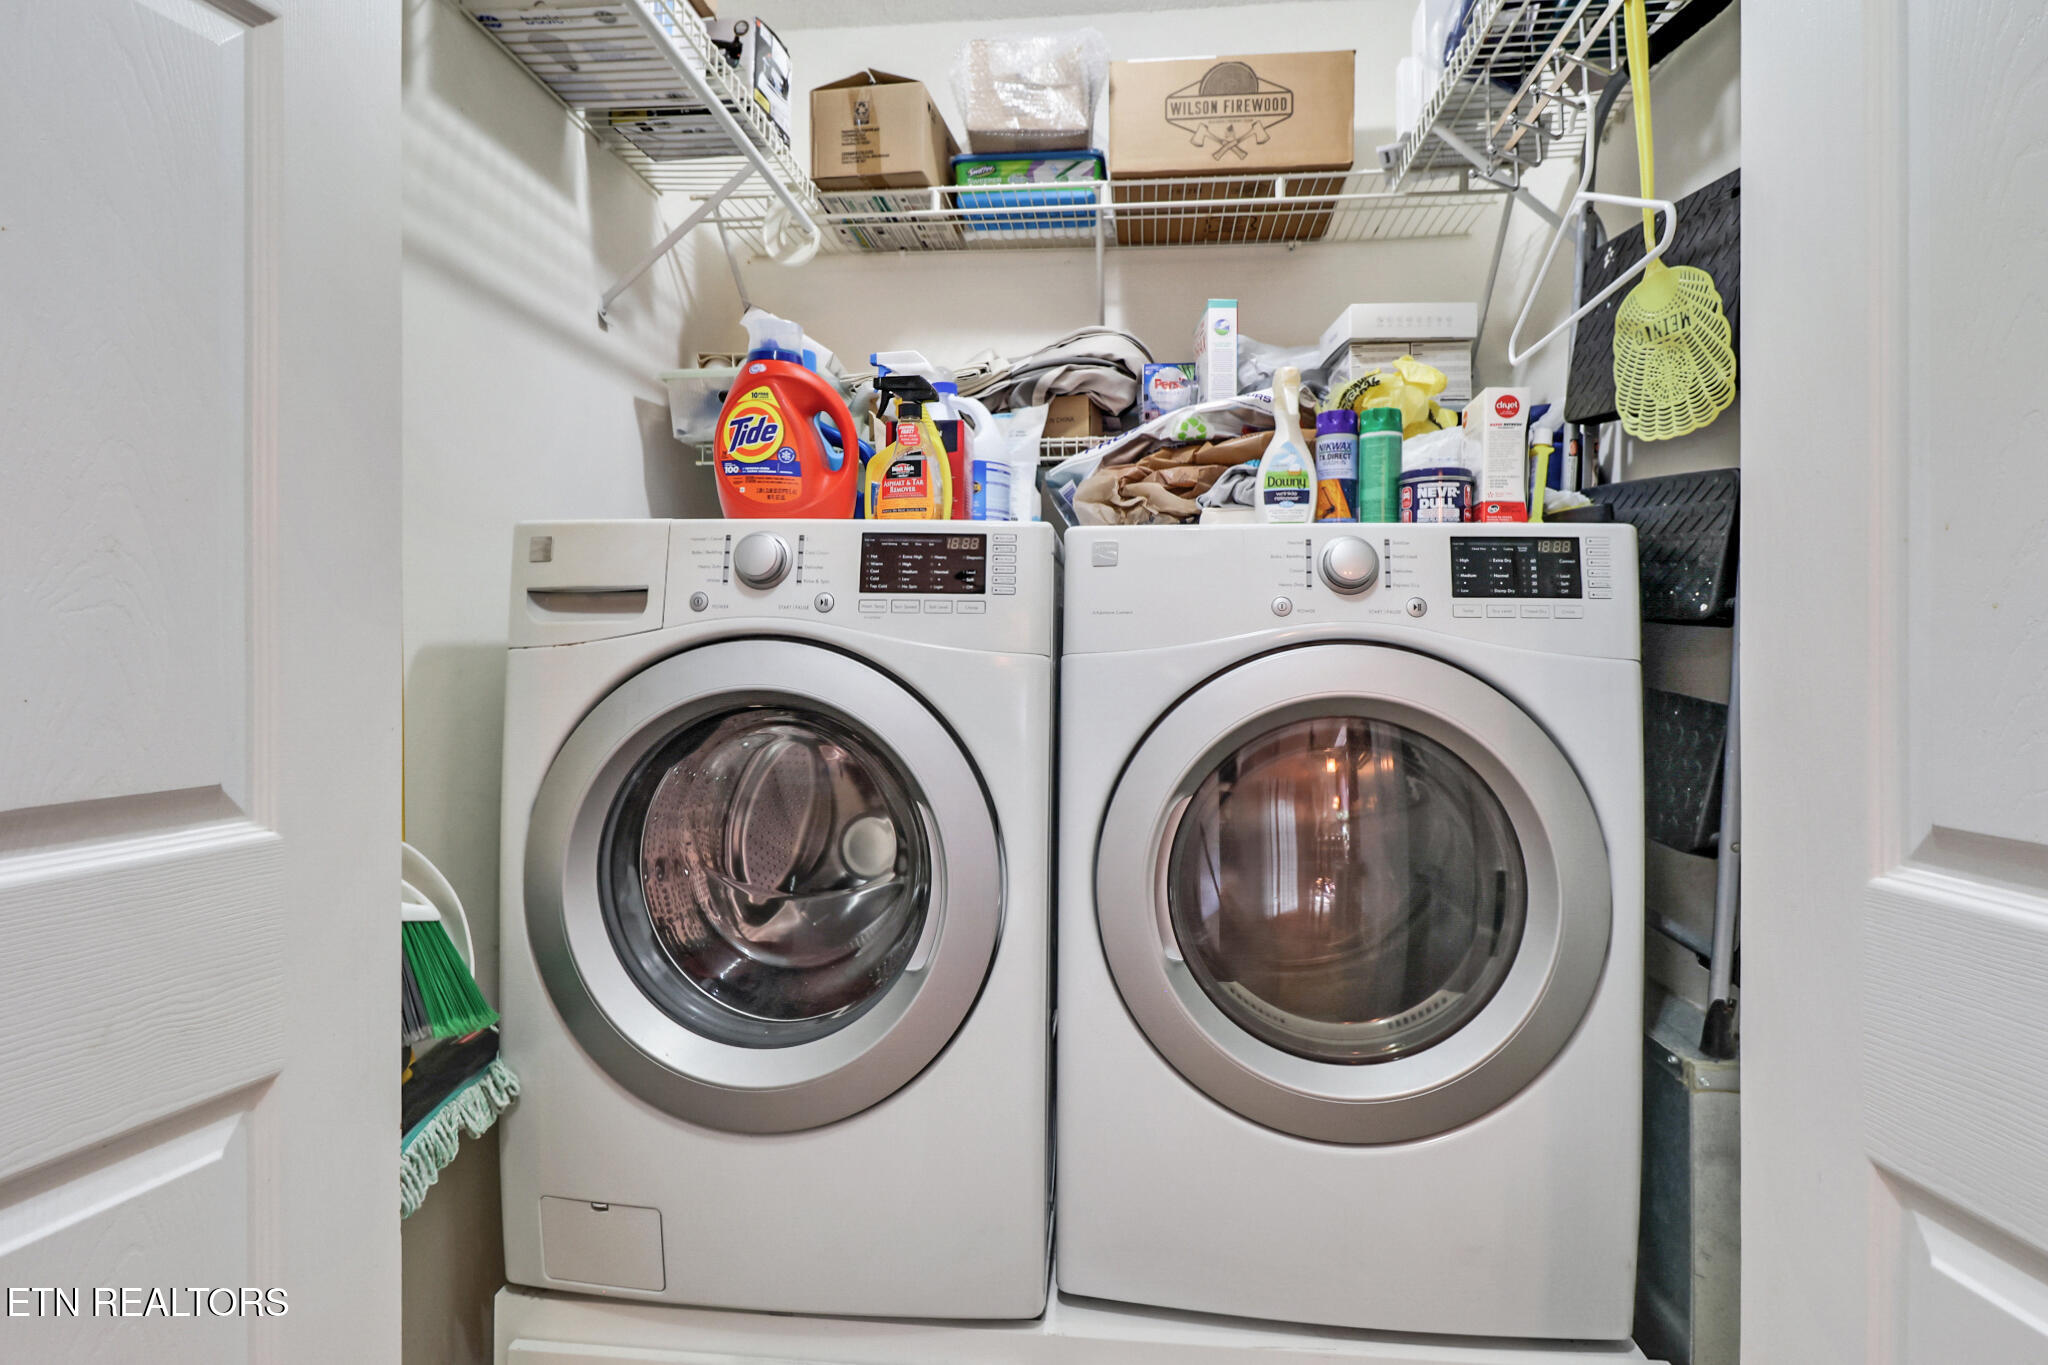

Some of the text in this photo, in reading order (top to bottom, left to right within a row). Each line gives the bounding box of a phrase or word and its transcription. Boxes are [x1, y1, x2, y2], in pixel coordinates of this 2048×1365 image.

[1170, 97, 1288, 116] WILSON FIREWOOD
[969, 165, 996, 177] Swiffer
[729, 415, 779, 455] Tide
[1319, 441, 1352, 452] NIKWAX
[724, 465, 740, 474] 100
[912, 478, 925, 486] TAR
[1267, 475, 1307, 490] Downy
[890, 486, 916, 494] REMOVER
[1417, 486, 1461, 499] NEVR-
[1419, 497, 1456, 509] DULL
